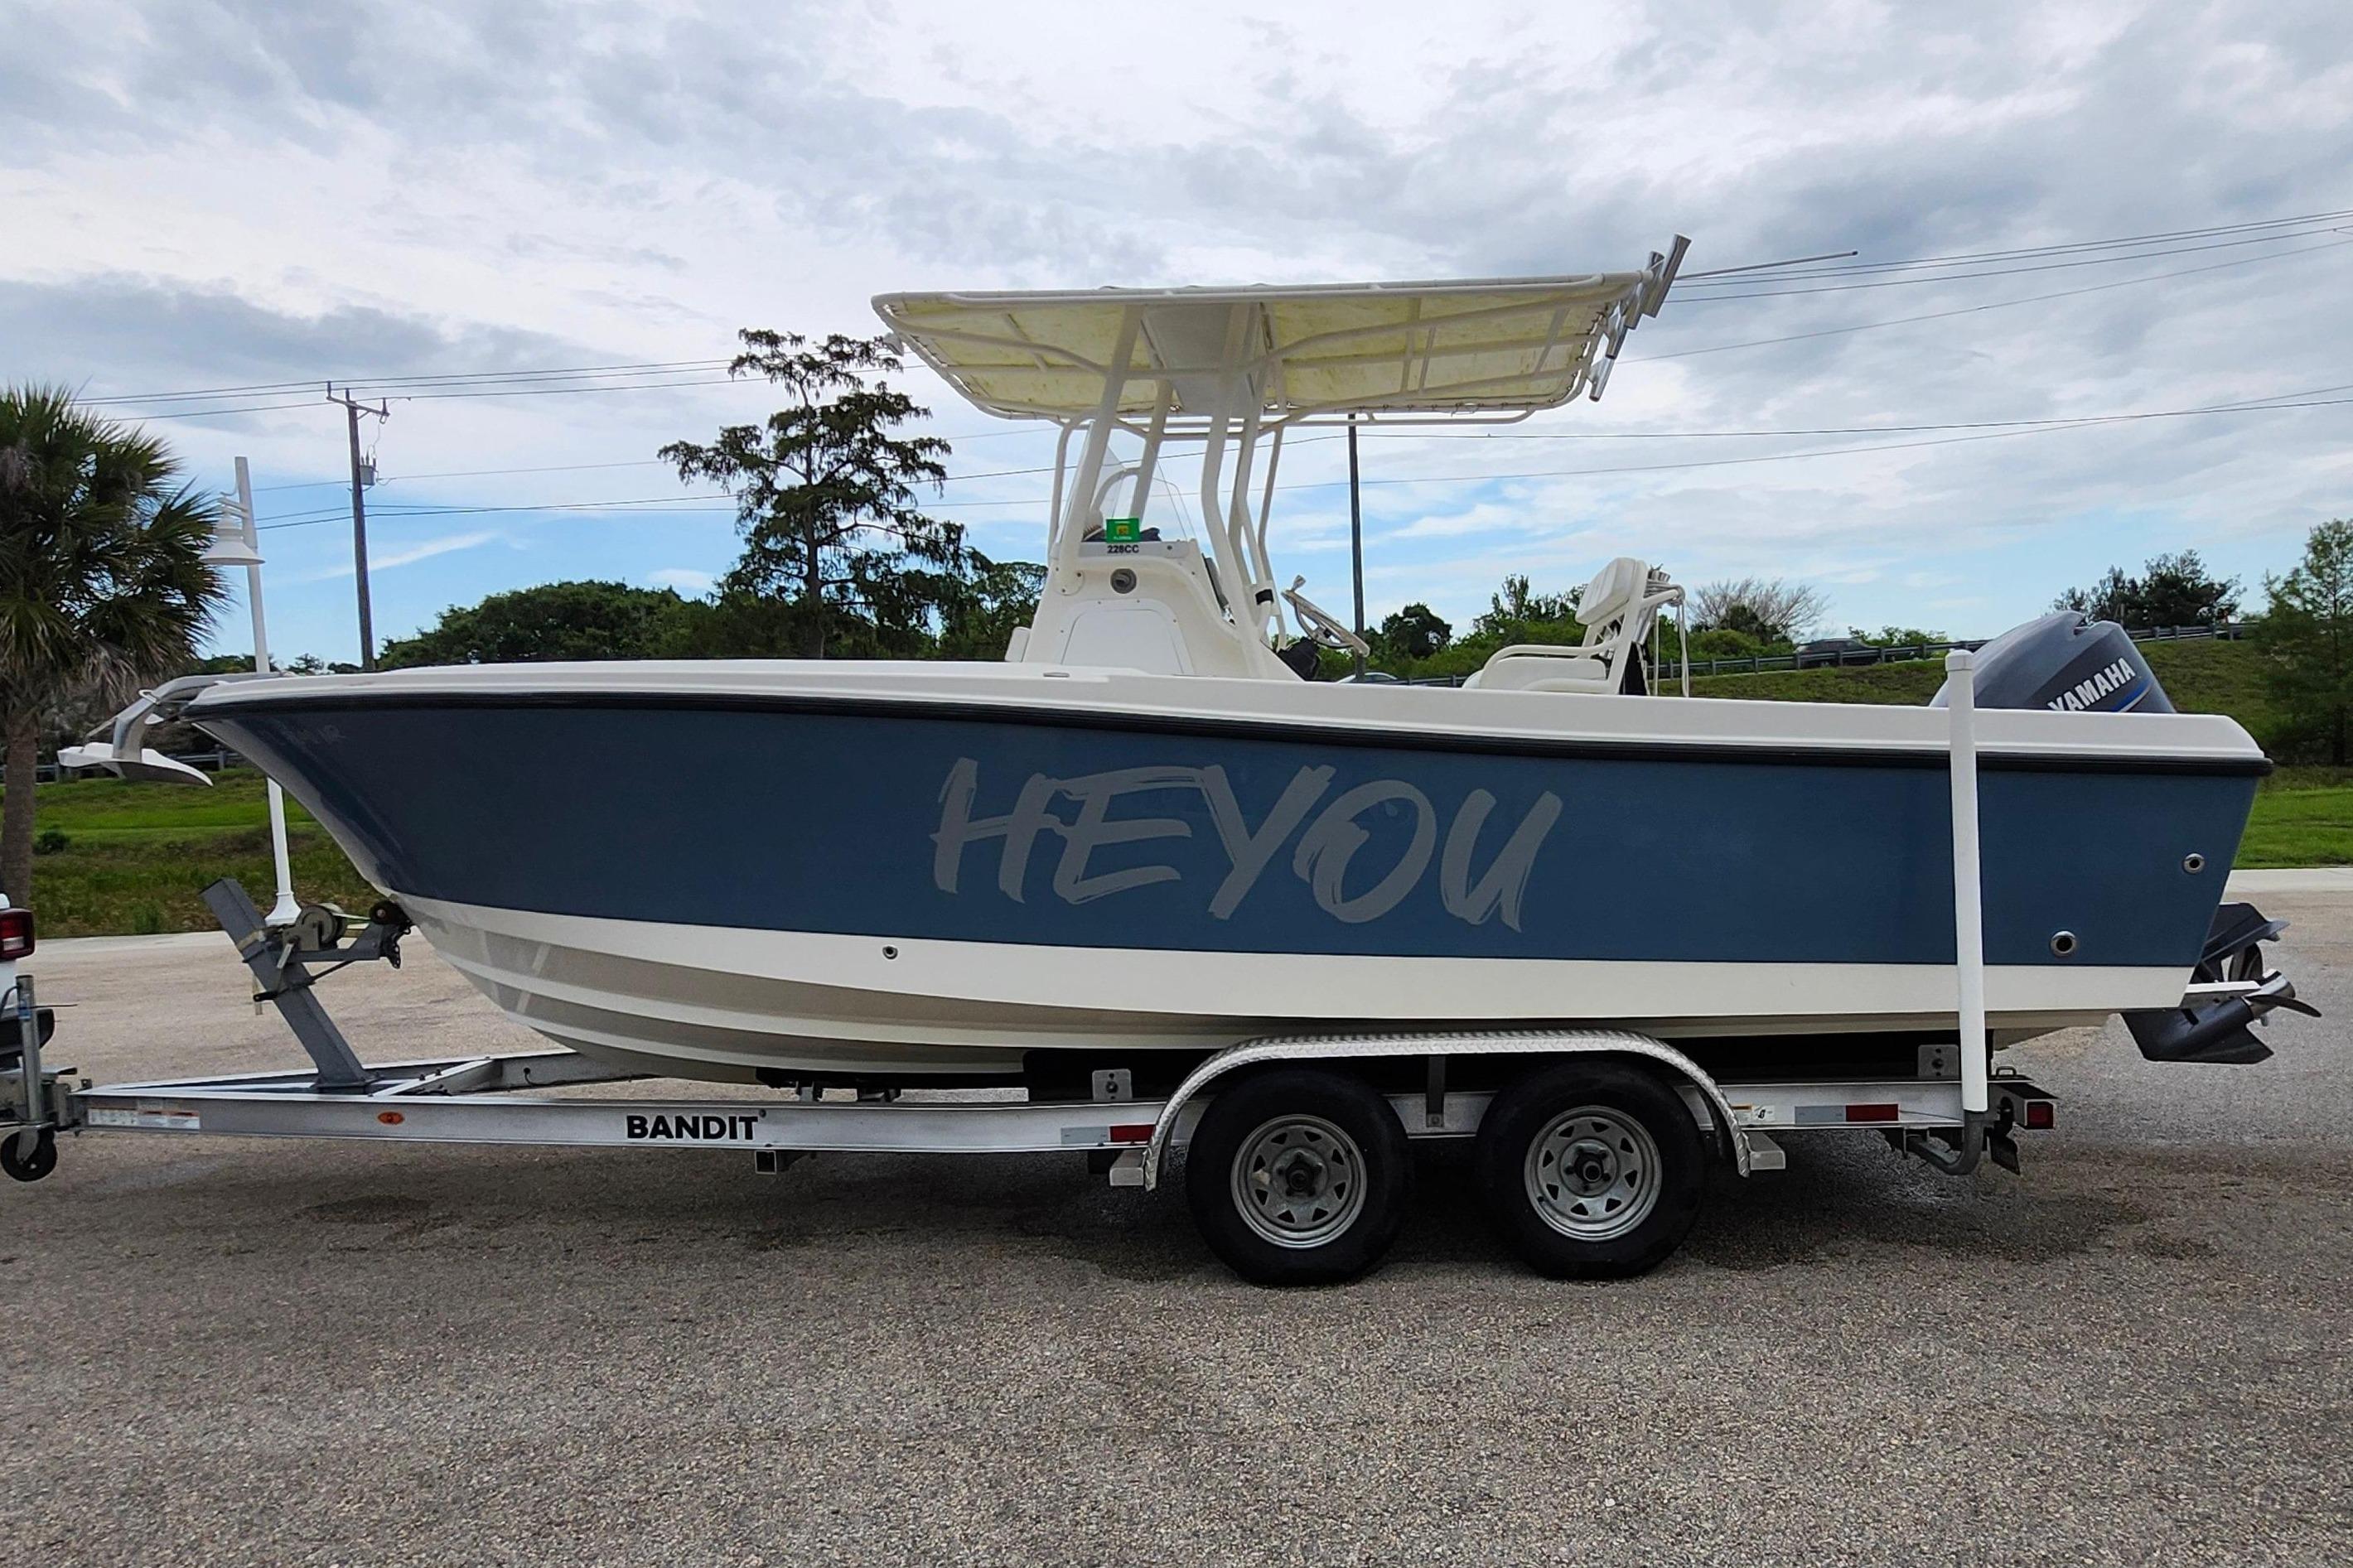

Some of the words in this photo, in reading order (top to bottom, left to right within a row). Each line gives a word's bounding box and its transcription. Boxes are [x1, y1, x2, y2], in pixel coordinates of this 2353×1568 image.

[2047, 658, 2136, 711] YAMAHA
[930, 757, 1563, 933] HEYOU
[626, 1115, 758, 1140] BANDIT
